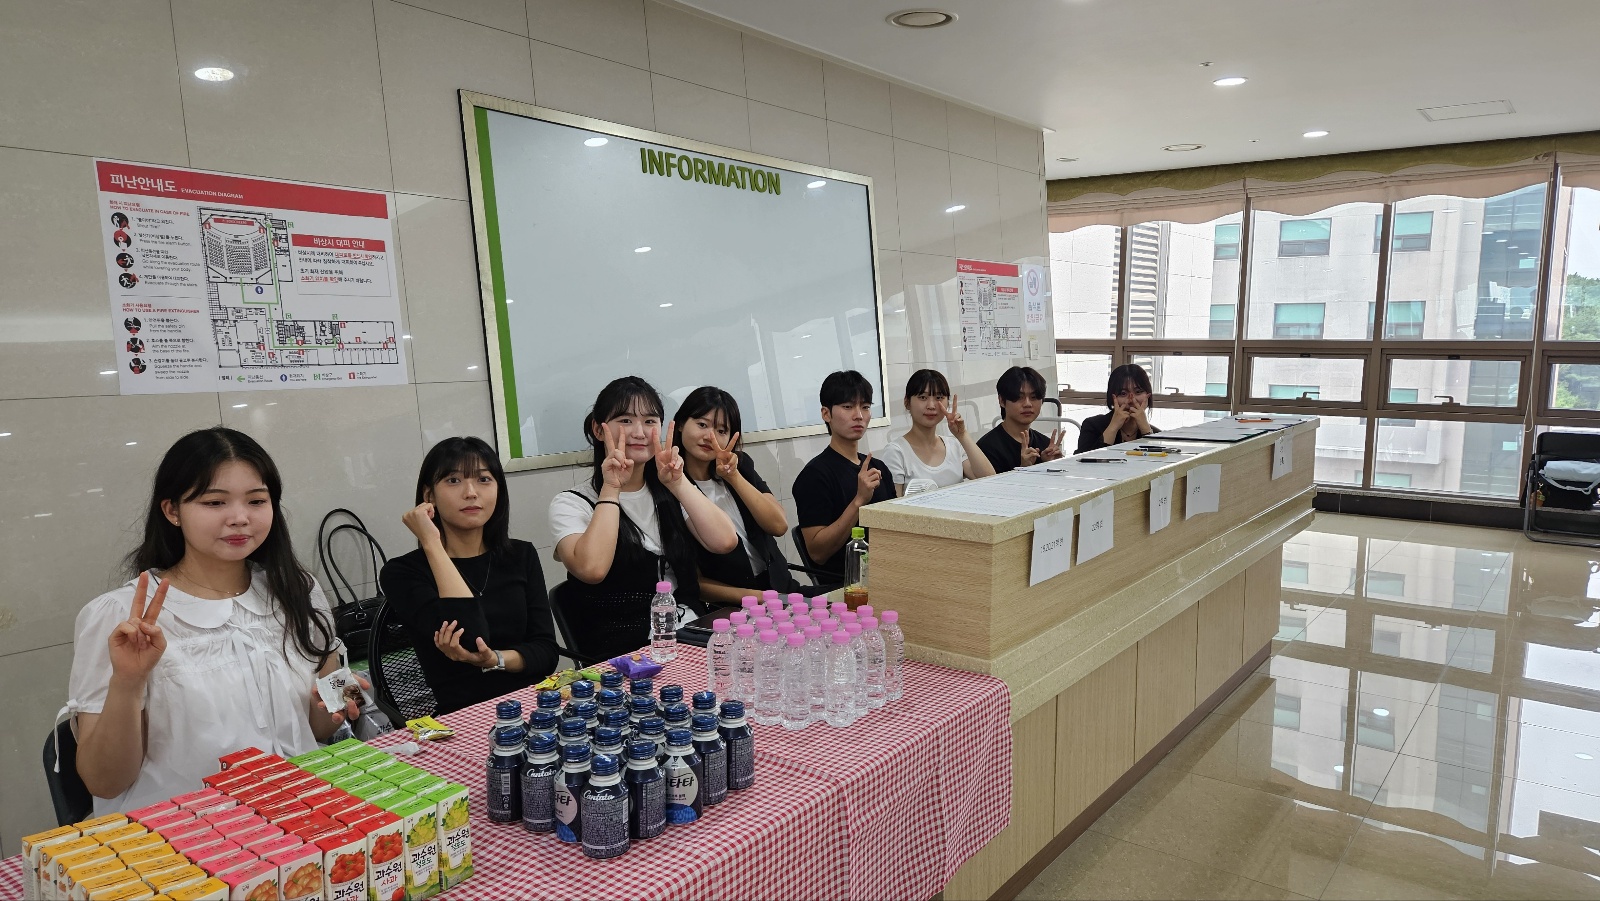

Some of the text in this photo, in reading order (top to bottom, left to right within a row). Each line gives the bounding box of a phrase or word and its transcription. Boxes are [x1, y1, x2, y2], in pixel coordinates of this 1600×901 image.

[640, 148, 781, 195] INFORMATION
[110, 174, 177, 192] 피난안내도
[181, 188, 216, 196] EVACUATION
[314, 238, 334, 247] 비상시
[377, 722, 392, 735] 과수
[666, 777, 695, 788] 타타
[584, 789, 615, 801] Cantata
[447, 828, 470, 846] 과수원
[451, 840, 466, 851] 청포도
[411, 845, 436, 863] 과수원
[416, 857, 432, 868] 청포도
[375, 861, 402, 880] 과수원
[381, 875, 398, 886] 사과
[334, 881, 364, 900] 과수원
